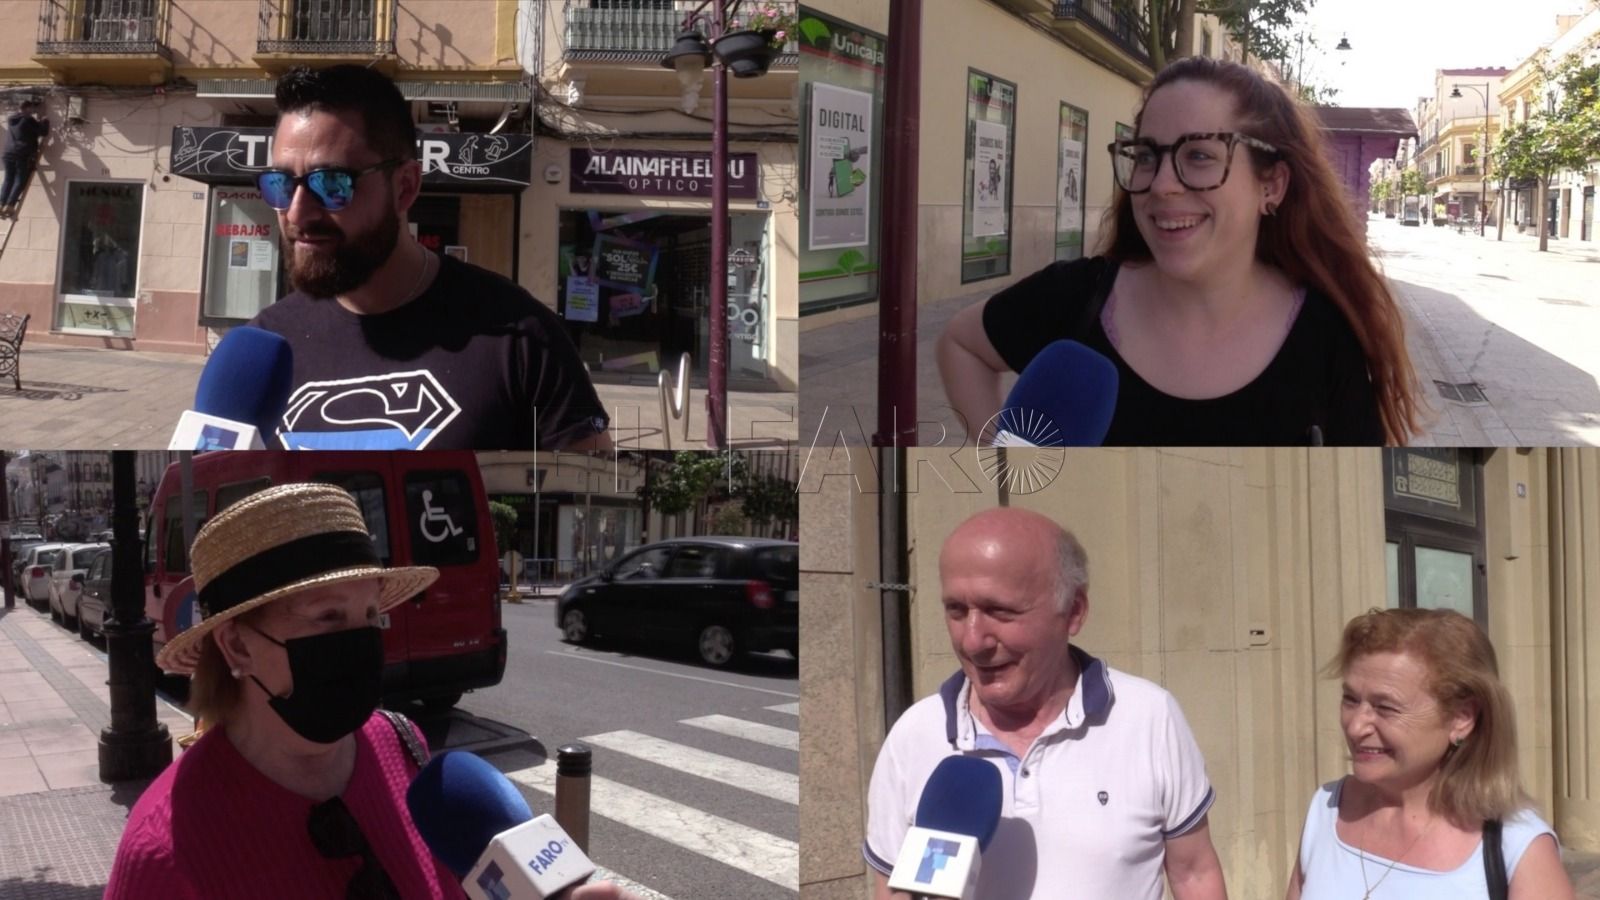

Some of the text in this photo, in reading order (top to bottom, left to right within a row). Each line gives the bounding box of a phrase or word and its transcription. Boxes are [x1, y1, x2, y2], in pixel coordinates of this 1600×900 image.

[833, 33, 884, 65] Unicaja
[819, 108, 865, 133] DIGITAL
[452, 165, 490, 175] CENTRO
[629, 178, 699, 191] OPTICO
[528, 840, 564, 876] FARO
